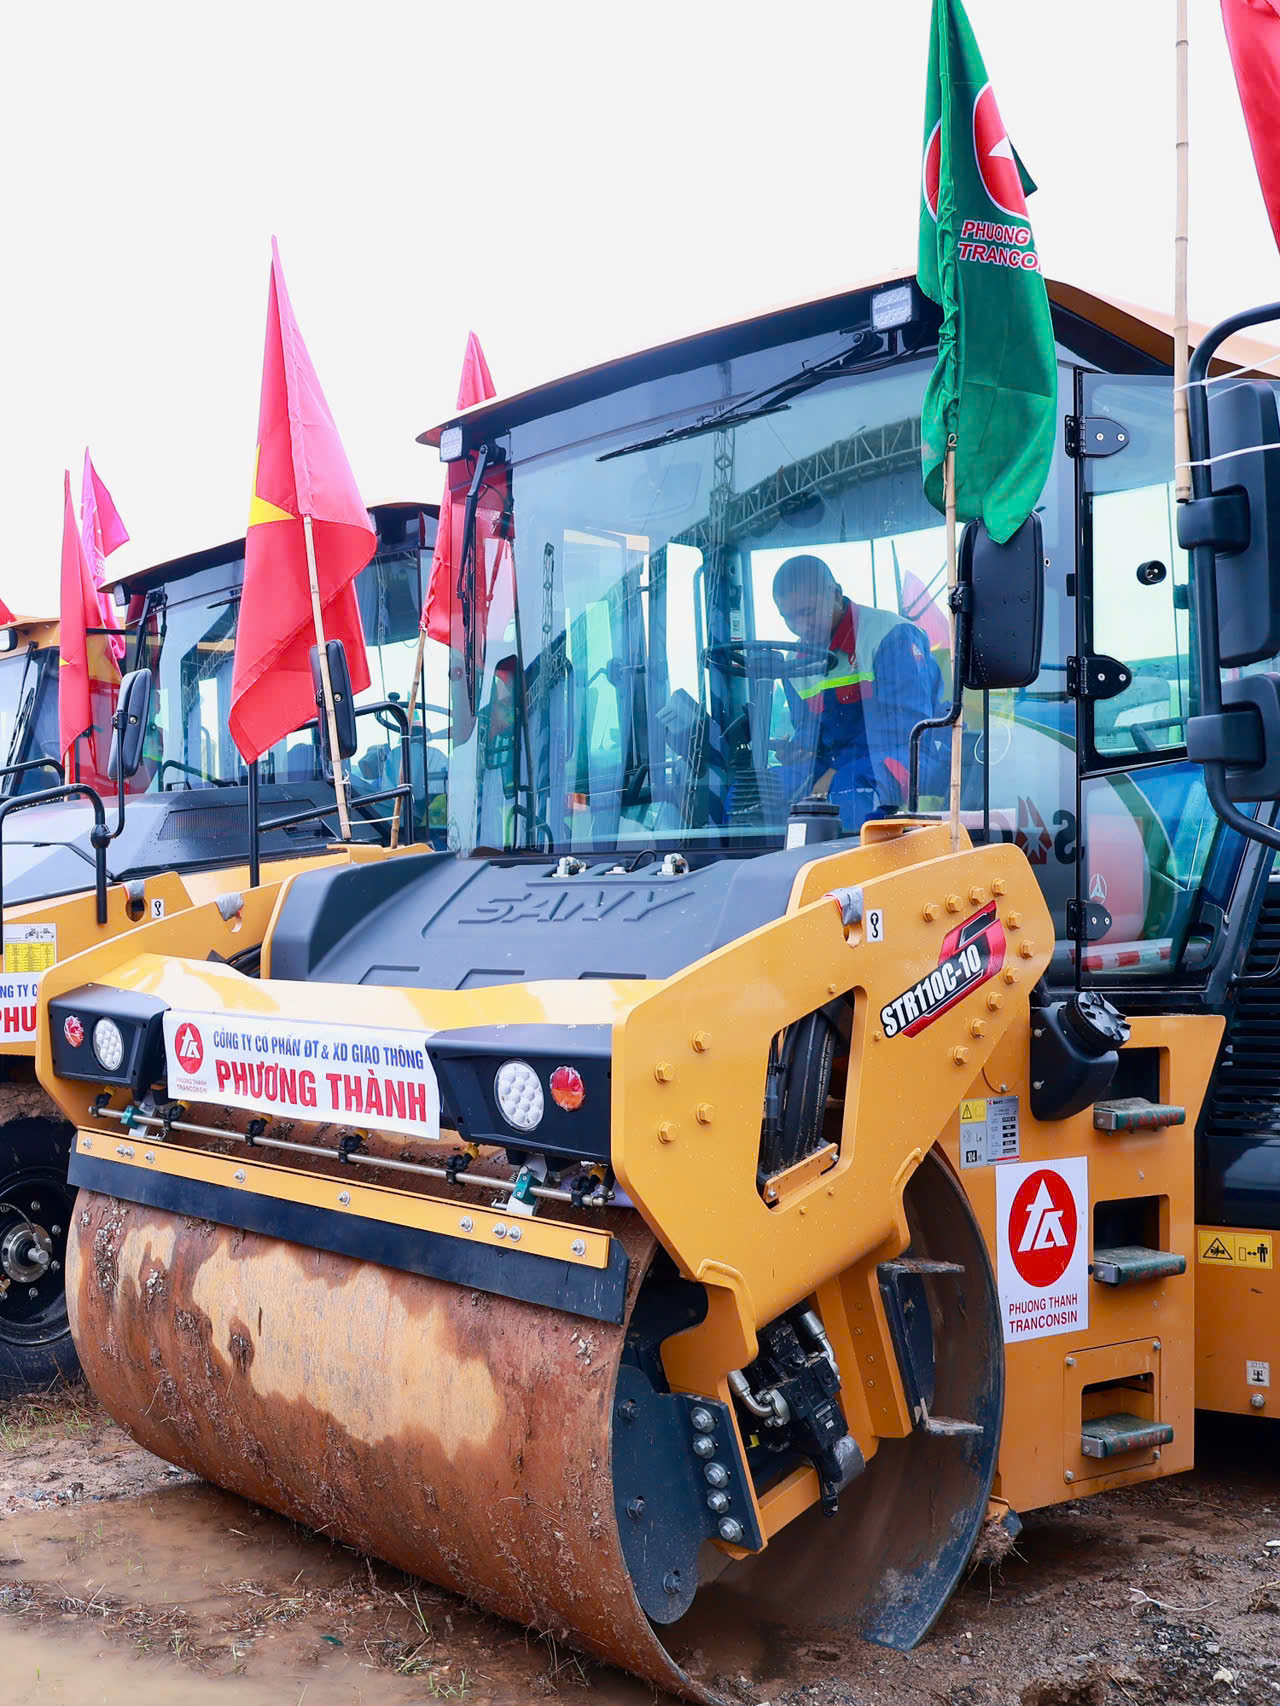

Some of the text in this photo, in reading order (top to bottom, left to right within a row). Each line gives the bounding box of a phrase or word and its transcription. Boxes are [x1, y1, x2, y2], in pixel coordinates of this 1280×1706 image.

[961, 219, 1031, 246] PHUONG
[958, 242, 1042, 273] TRANCO
[17, 984, 28, 998] TY
[881, 944, 982, 1038] STR110C-10
[241, 1033, 252, 1051] TY
[304, 1039, 319, 1058] ĐT
[321, 1044, 329, 1059] &
[333, 1042, 348, 1061] XD
[352, 1043, 380, 1064] GIAO
[383, 1045, 424, 1070] THÔNG
[215, 1059, 427, 1123] PHƯƠNG THÀNH
[1009, 1293, 1078, 1316] PHUONG THANH
[1009, 1310, 1078, 1333] TRANCONSIN
